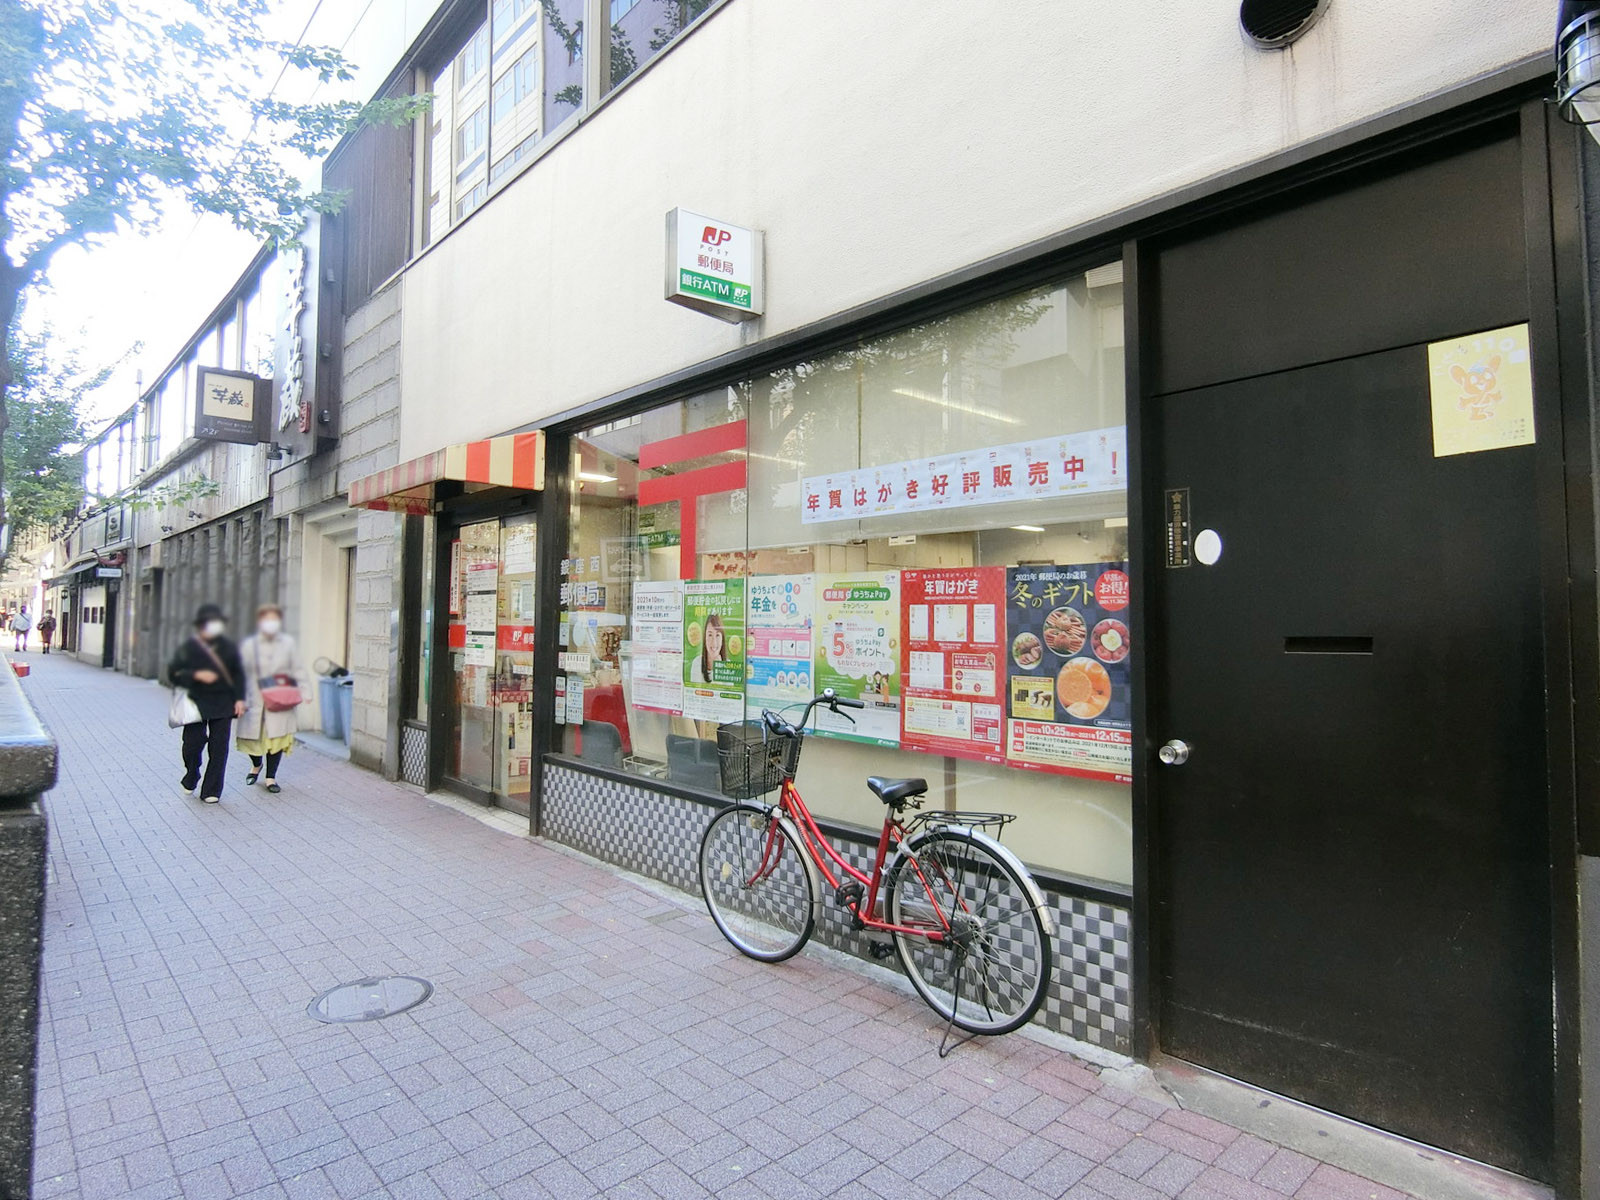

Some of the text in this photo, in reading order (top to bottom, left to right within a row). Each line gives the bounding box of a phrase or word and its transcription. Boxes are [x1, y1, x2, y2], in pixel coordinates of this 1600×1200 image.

[702, 226, 732, 246] JP
[700, 244, 729, 256] POST
[698, 254, 734, 275] 郵便局
[682, 273, 730, 296] 銀行ATM
[807, 451, 1118, 512] 年賀はがき好評販売中!
[560, 556, 600, 575] 銀座西
[560, 581, 599, 605] 郵便局
[752, 585, 777, 594] ゆうちょで
[925, 578, 979, 595] 年賀はがき
[1010, 581, 1094, 608] 冬のギフト
[751, 596, 777, 613] 年金を
